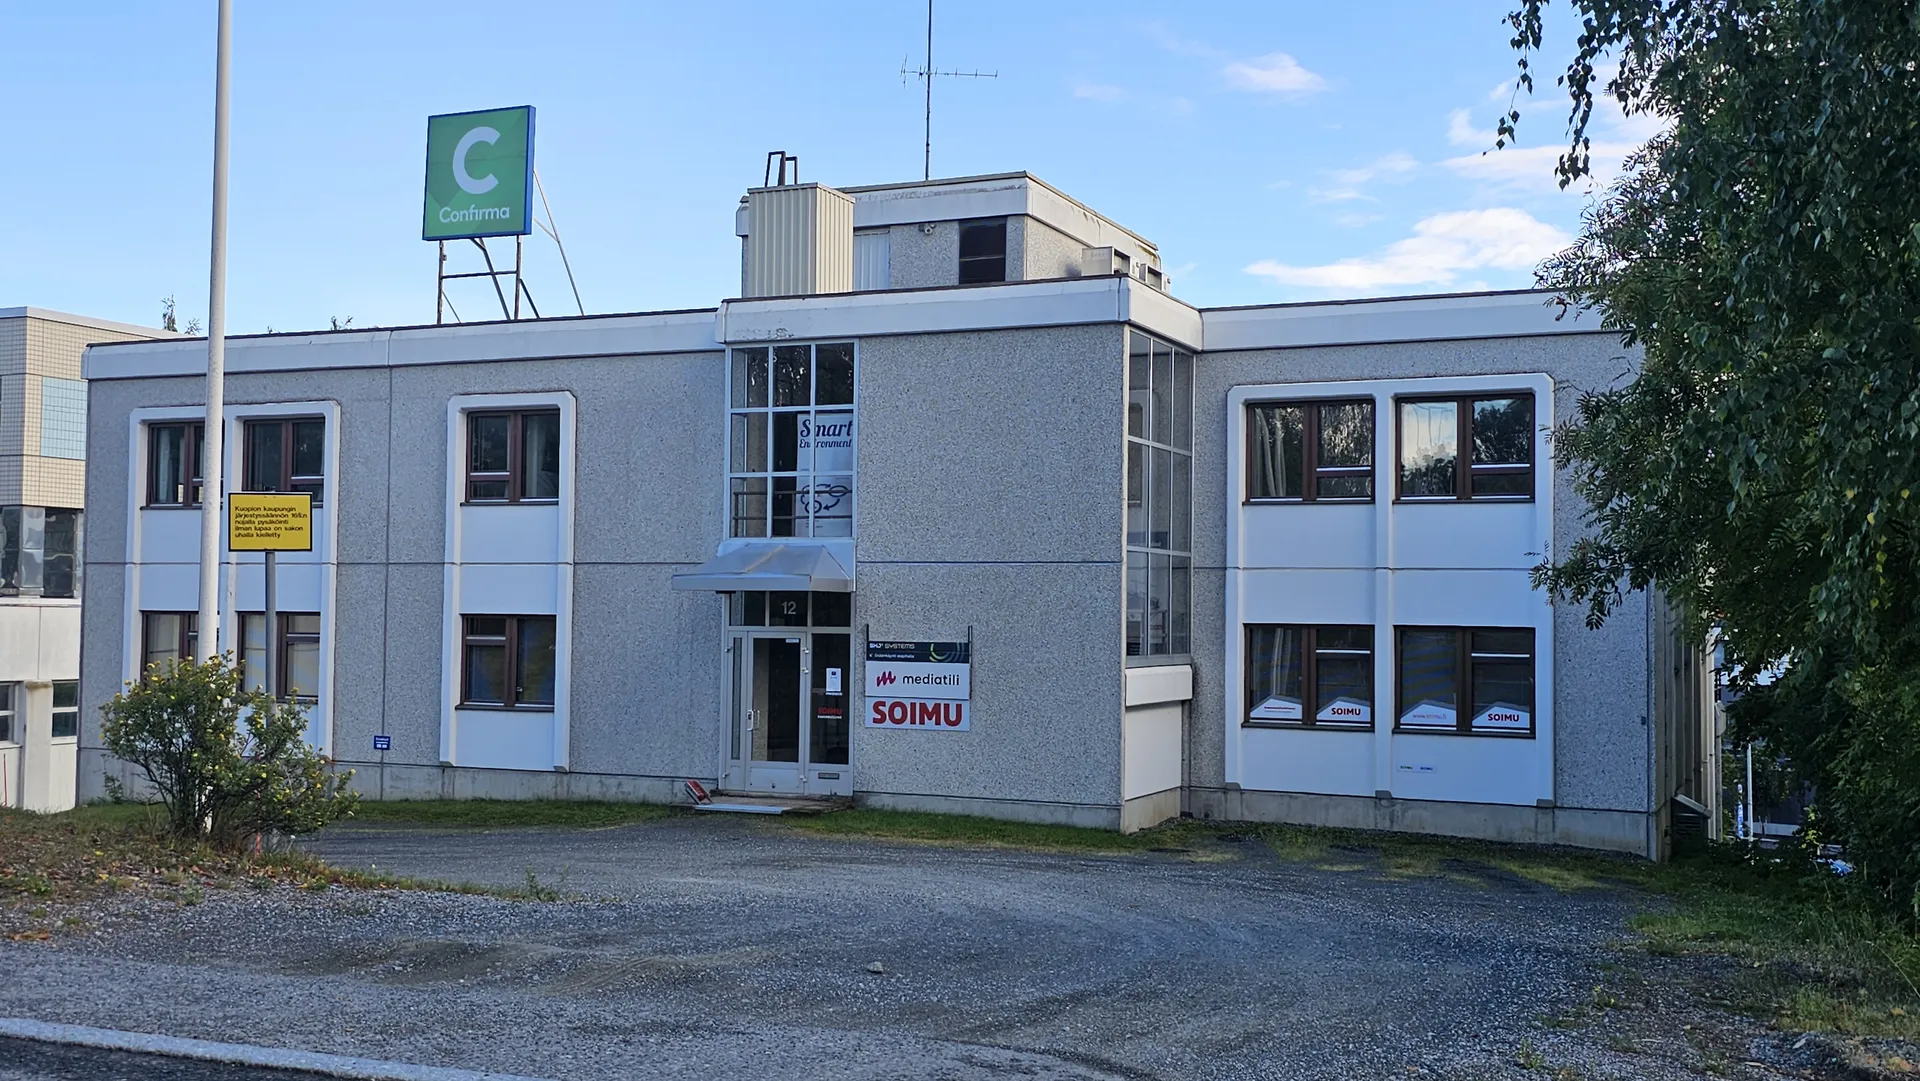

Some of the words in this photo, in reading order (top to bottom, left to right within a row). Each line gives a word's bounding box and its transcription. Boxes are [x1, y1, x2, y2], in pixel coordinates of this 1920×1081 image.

[453, 126, 501, 195] C
[439, 204, 510, 223] Confirma
[800, 419, 853, 437] Smart
[800, 438, 852, 448] Enronment
[782, 601, 797, 615] 12
[902, 673, 960, 686] mediatili
[872, 700, 963, 727] SOIMU
[1331, 707, 1361, 716] SOIMU
[1487, 713, 1520, 722] SOIMU
